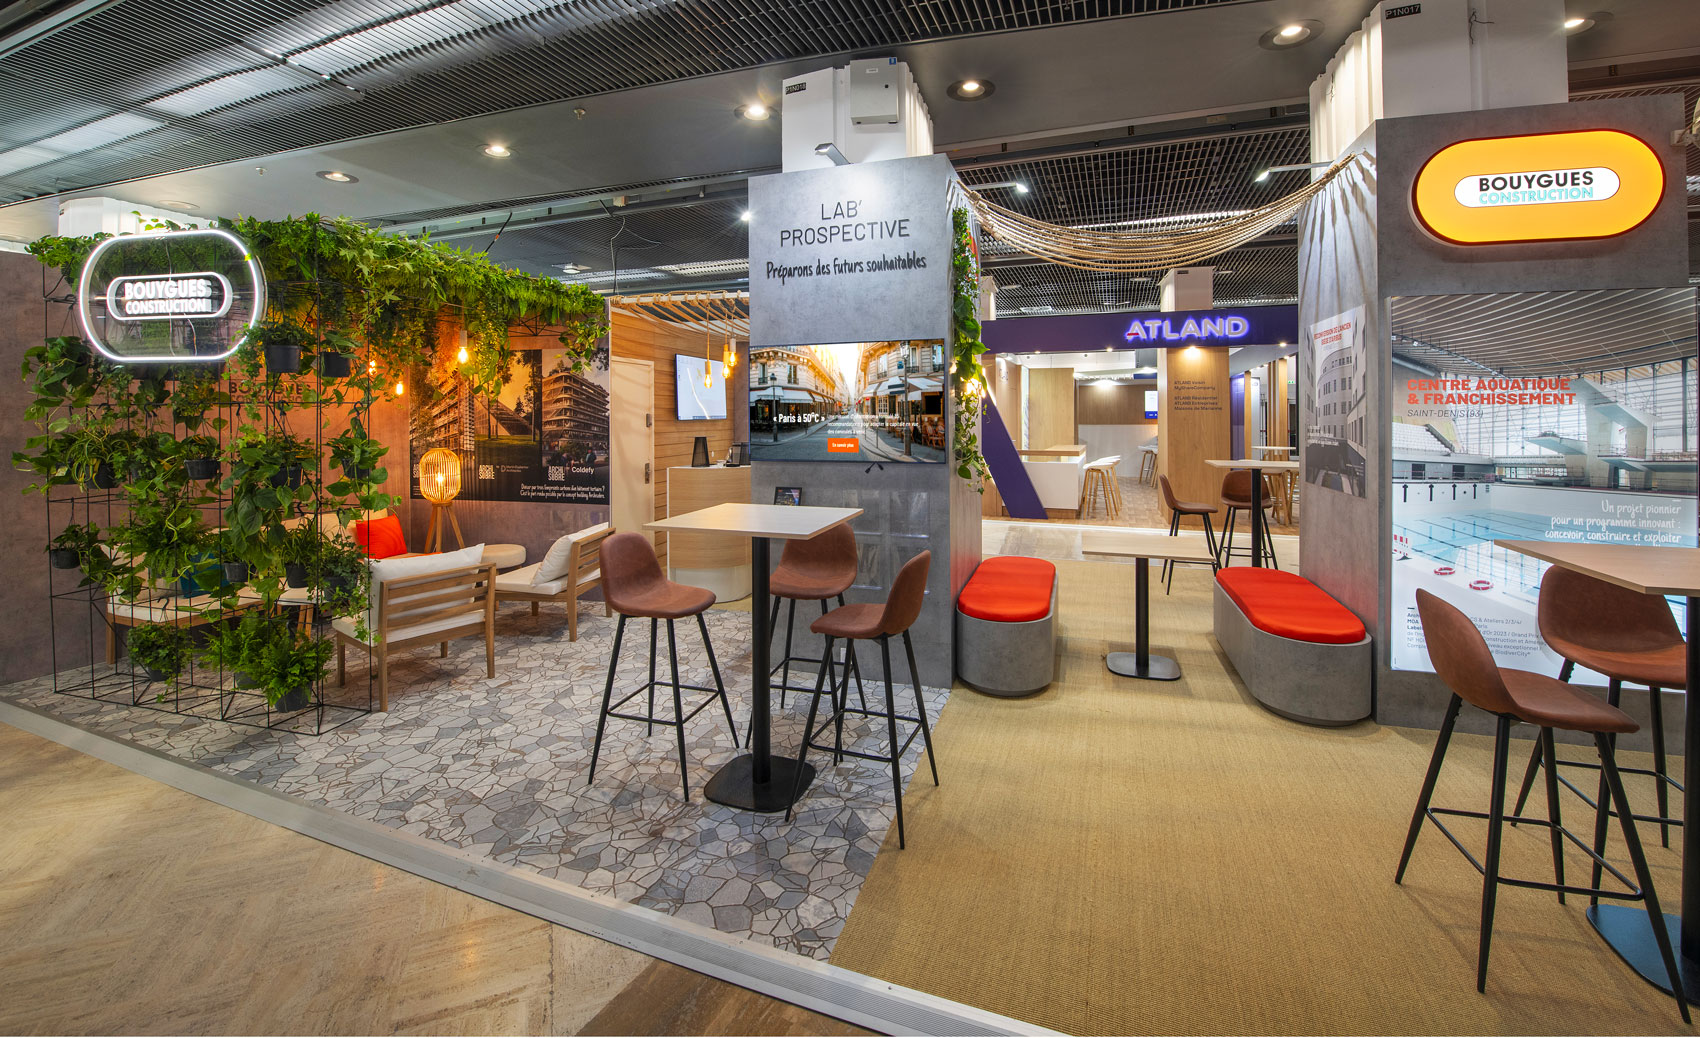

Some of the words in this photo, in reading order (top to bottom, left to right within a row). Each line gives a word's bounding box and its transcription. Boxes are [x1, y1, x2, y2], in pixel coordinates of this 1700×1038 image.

[1386, 5, 1420, 17] P1N017
[1479, 171, 1594, 192] BOUYGUES
[1479, 187, 1593, 204] CONSTRUCTION
[780, 219, 910, 247] PROSPECTIVE
[766, 261, 813, 285] Préparons
[816, 259, 831, 276] des
[833, 257, 864, 275] futurs
[866, 250, 927, 273] souhaitables
[124, 279, 208, 300] BOUYGUES
[125, 298, 207, 314] CONSTRUCTION
[1126, 316, 1249, 340] ATLAND
[1407, 378, 1472, 391] CENTRE
[1475, 378, 1572, 392] AQUATIQUE
[1407, 393, 1419, 405] &
[1423, 392, 1577, 405] FRANCHISSEMENT
[778, 413, 796, 423] Paris
[797, 413, 802, 423] à
[1407, 409, 1465, 418] SAINT-DENIS
[571, 466, 595, 475] Coldefy
[1601, 500, 1615, 513] Un
[1617, 503, 1644, 518] projet
[1645, 504, 1682, 518] pionnier
[1551, 517, 1571, 529] pour
[1573, 517, 1584, 526] un
[1586, 517, 1637, 531] programme
[1638, 518, 1676, 529] innovant
[1545, 530, 1585, 541] concevoir,
[1587, 530, 1631, 541] construire
[1633, 531, 1641, 541] et
[1643, 530, 1682, 545] exploiter
